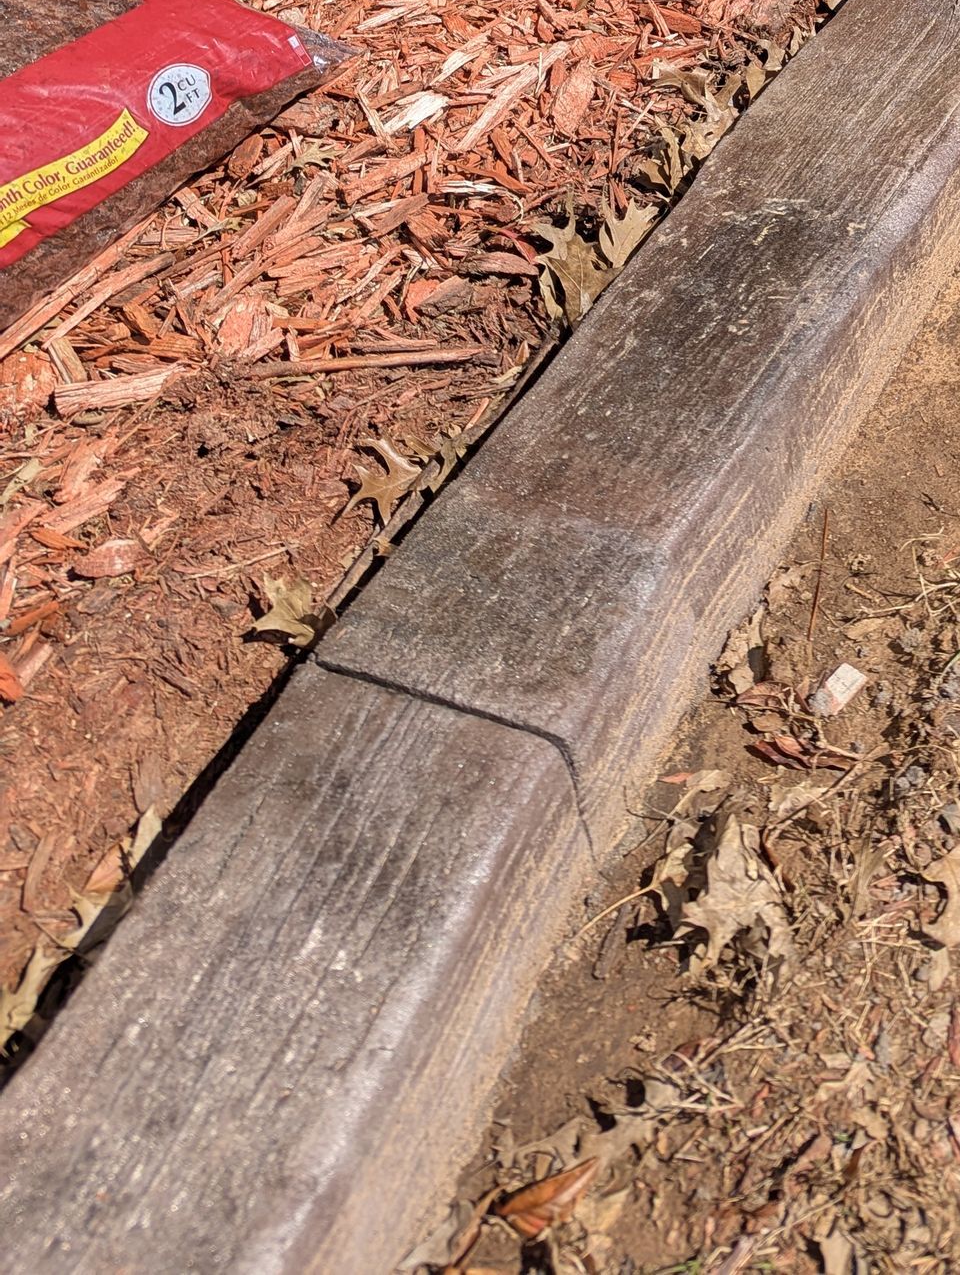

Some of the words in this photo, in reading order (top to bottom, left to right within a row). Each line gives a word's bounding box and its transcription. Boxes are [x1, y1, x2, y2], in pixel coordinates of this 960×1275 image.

[159, 81, 187, 116] 2
[177, 73, 196, 92] CU
[185, 87, 200, 104] FT
[21, 170, 67, 196] Color,
[65, 120, 137, 175] Guaranteed!
[13, 198, 37, 216] Meses
[38, 191, 49, 203] de
[48, 182, 72, 197] Color
